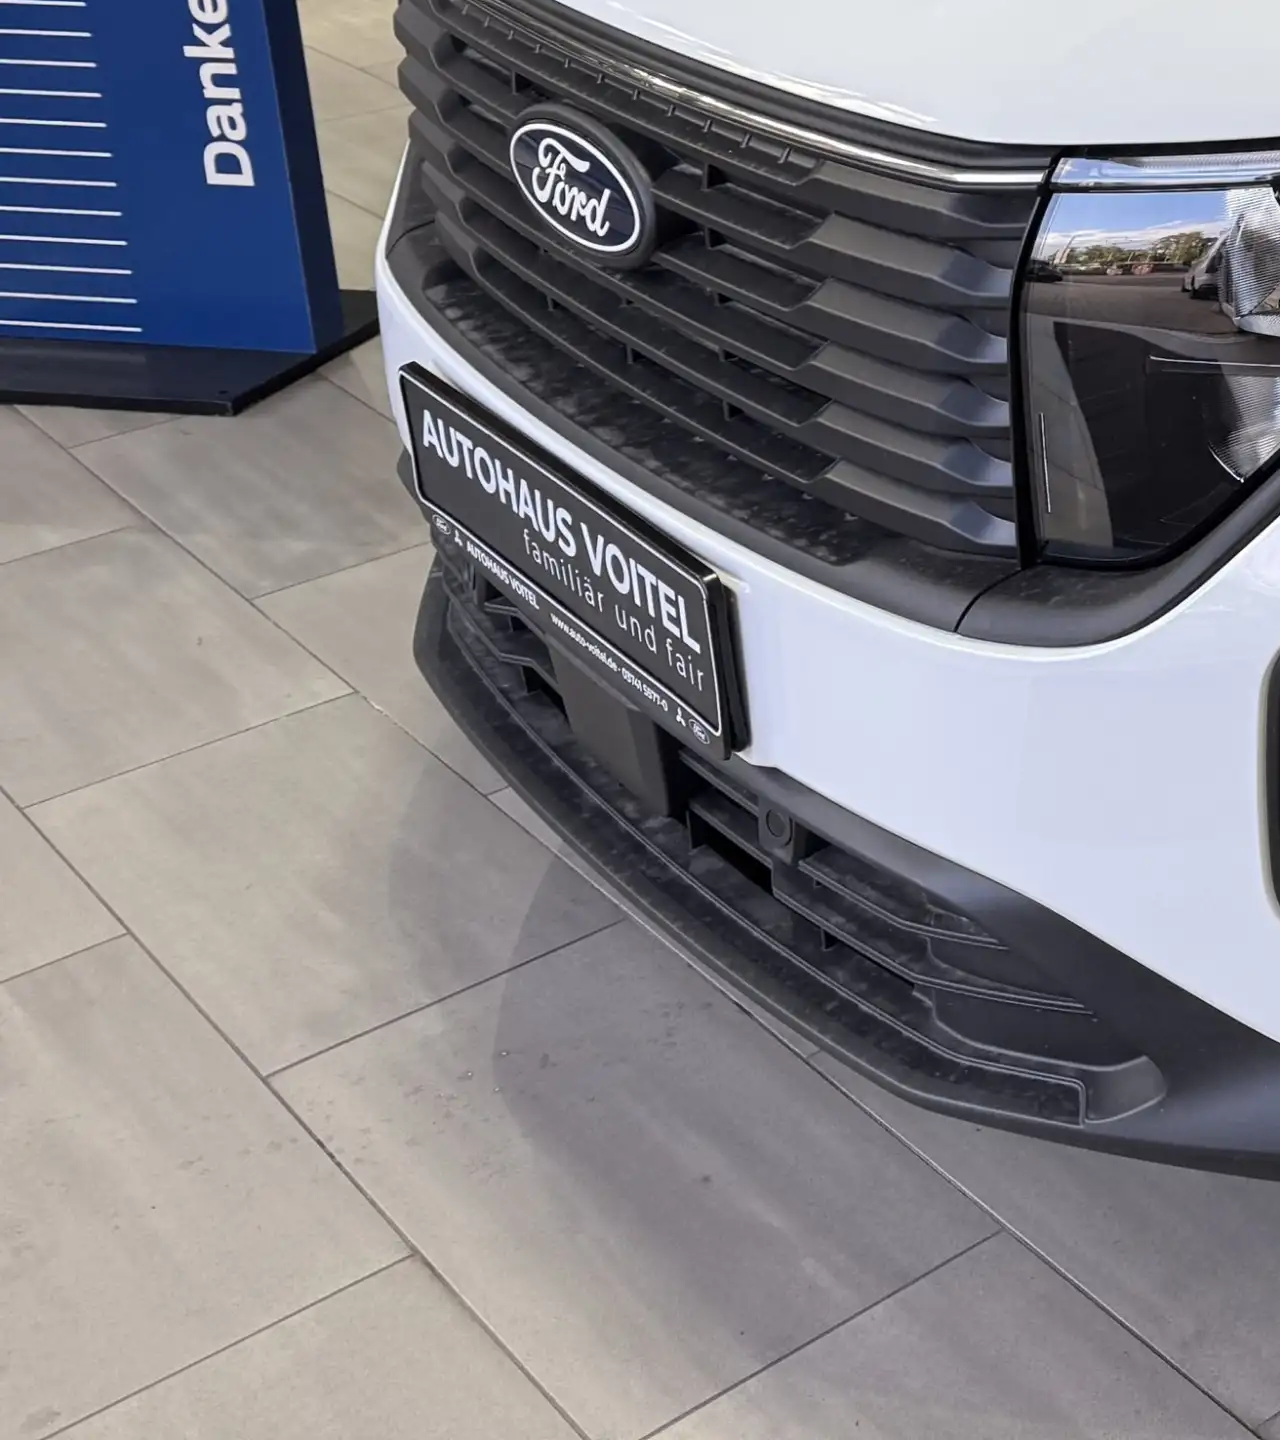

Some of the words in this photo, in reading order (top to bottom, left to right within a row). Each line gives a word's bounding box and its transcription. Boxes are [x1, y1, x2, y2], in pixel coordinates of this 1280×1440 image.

[531, 137, 612, 237] Ford
[423, 409, 577, 558] AUTOHAUS
[580, 522, 701, 655] VOITEL
[466, 540, 510, 585] AUTOHAUS
[509, 575, 540, 610] VOITEL
[523, 528, 604, 613] familiär
[614, 603, 657, 655] und
[665, 637, 704, 692] fair
